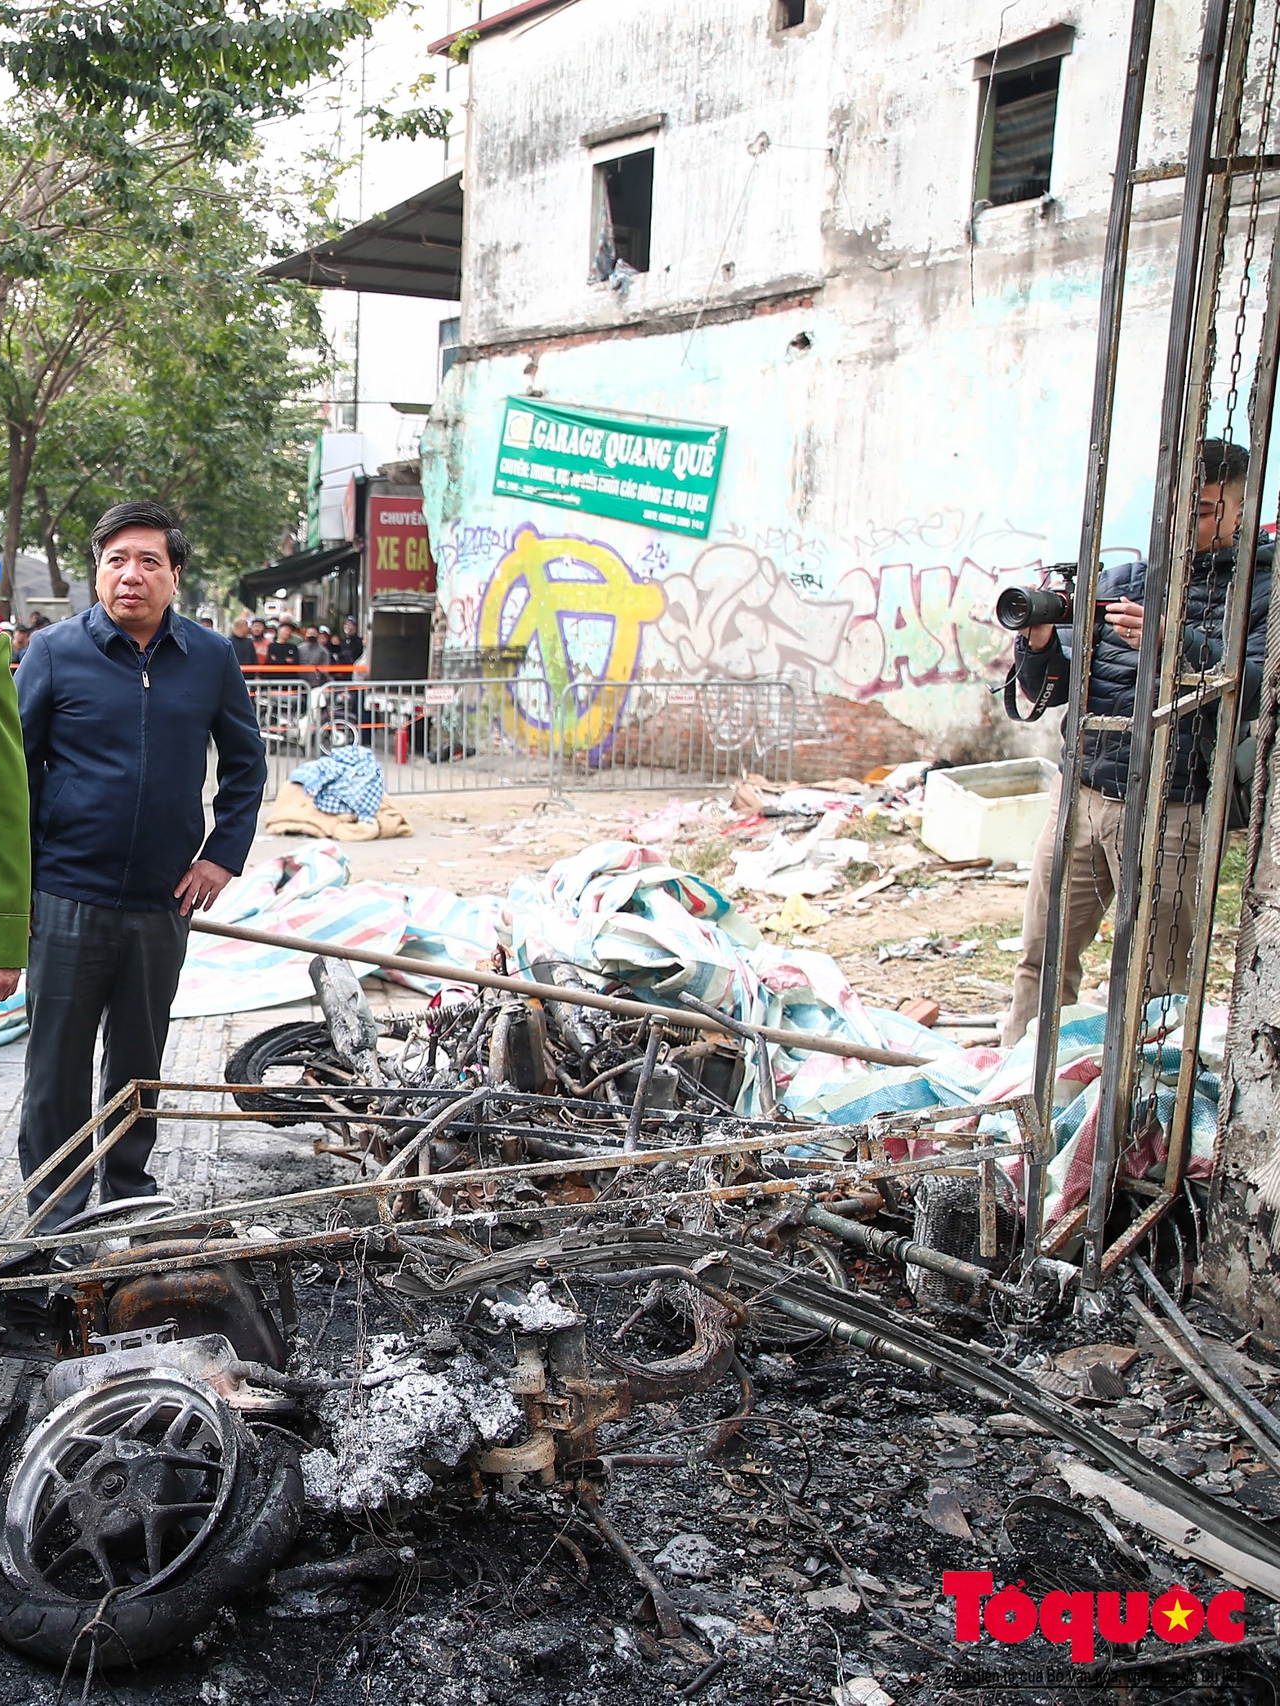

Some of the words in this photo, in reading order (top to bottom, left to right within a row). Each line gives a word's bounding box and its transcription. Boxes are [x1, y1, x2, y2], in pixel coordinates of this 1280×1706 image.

[533, 418, 606, 461] GARAGE
[603, 433, 672, 472] QUANG
[672, 432, 721, 481] QUẾ
[660, 488, 675, 506] XE
[674, 490, 688, 508] DU
[687, 493, 709, 515] LỊCH
[376, 535, 401, 571] XE
[404, 536, 431, 572] GA
[1035, 683, 1055, 714] SONY
